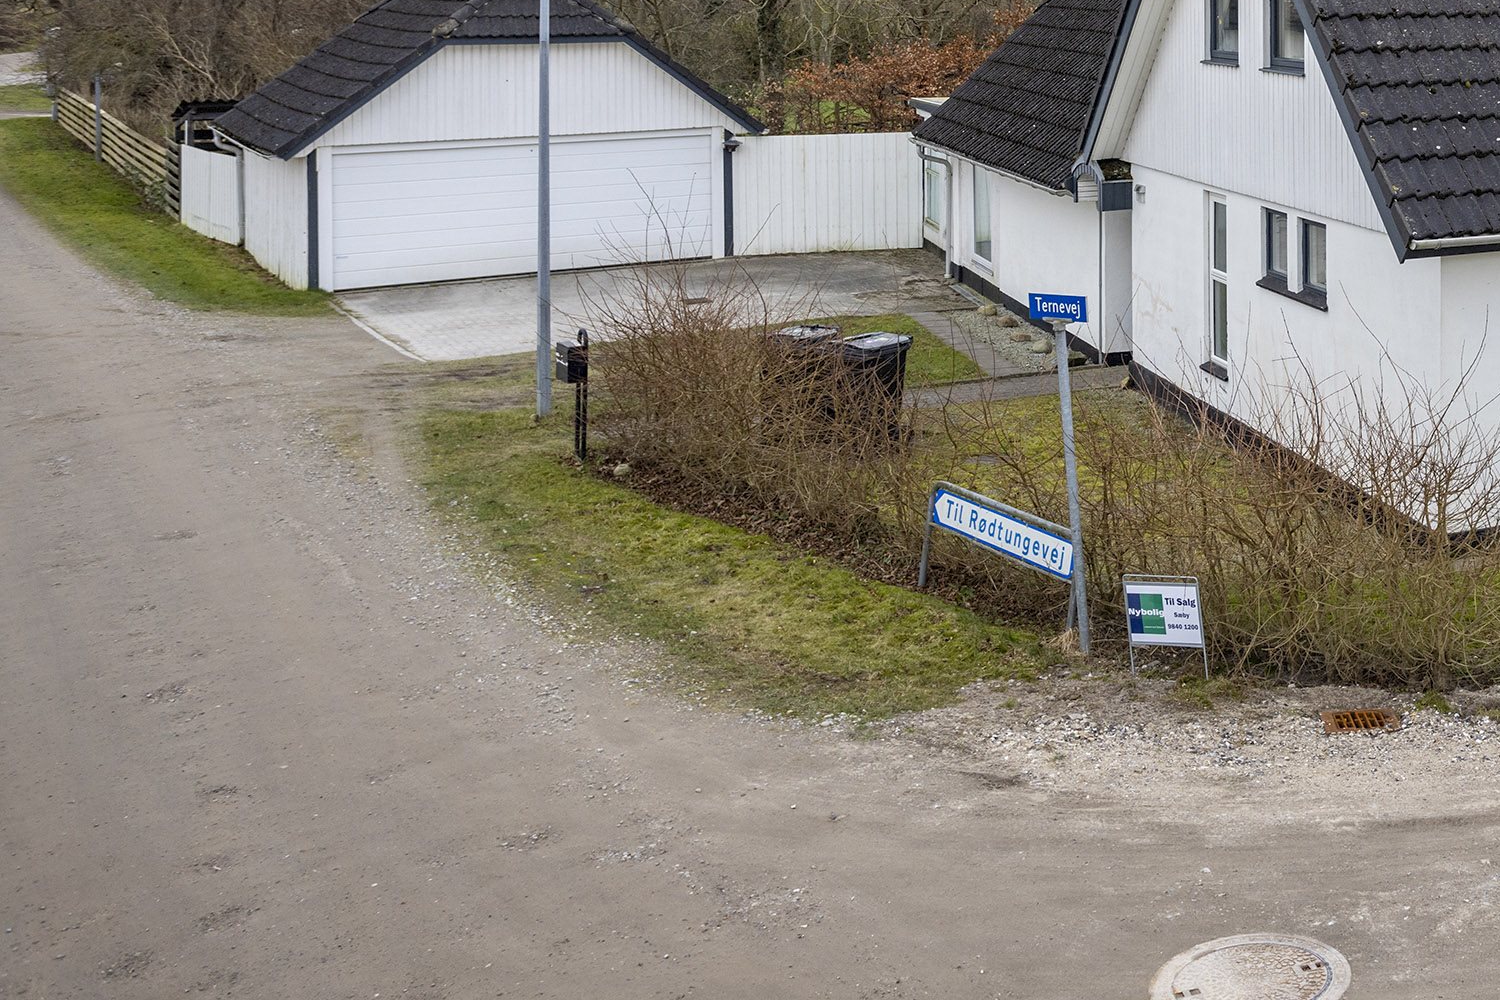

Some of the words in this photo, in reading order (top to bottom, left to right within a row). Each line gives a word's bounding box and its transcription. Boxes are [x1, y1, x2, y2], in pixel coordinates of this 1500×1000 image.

[1034, 296, 1081, 319] Ternevej
[946, 499, 963, 524] Til
[968, 509, 1066, 570] Rødtungevej
[1164, 597, 1175, 606] Til
[1176, 598, 1197, 608] Salg
[1128, 608, 1165, 617] Nybolig
